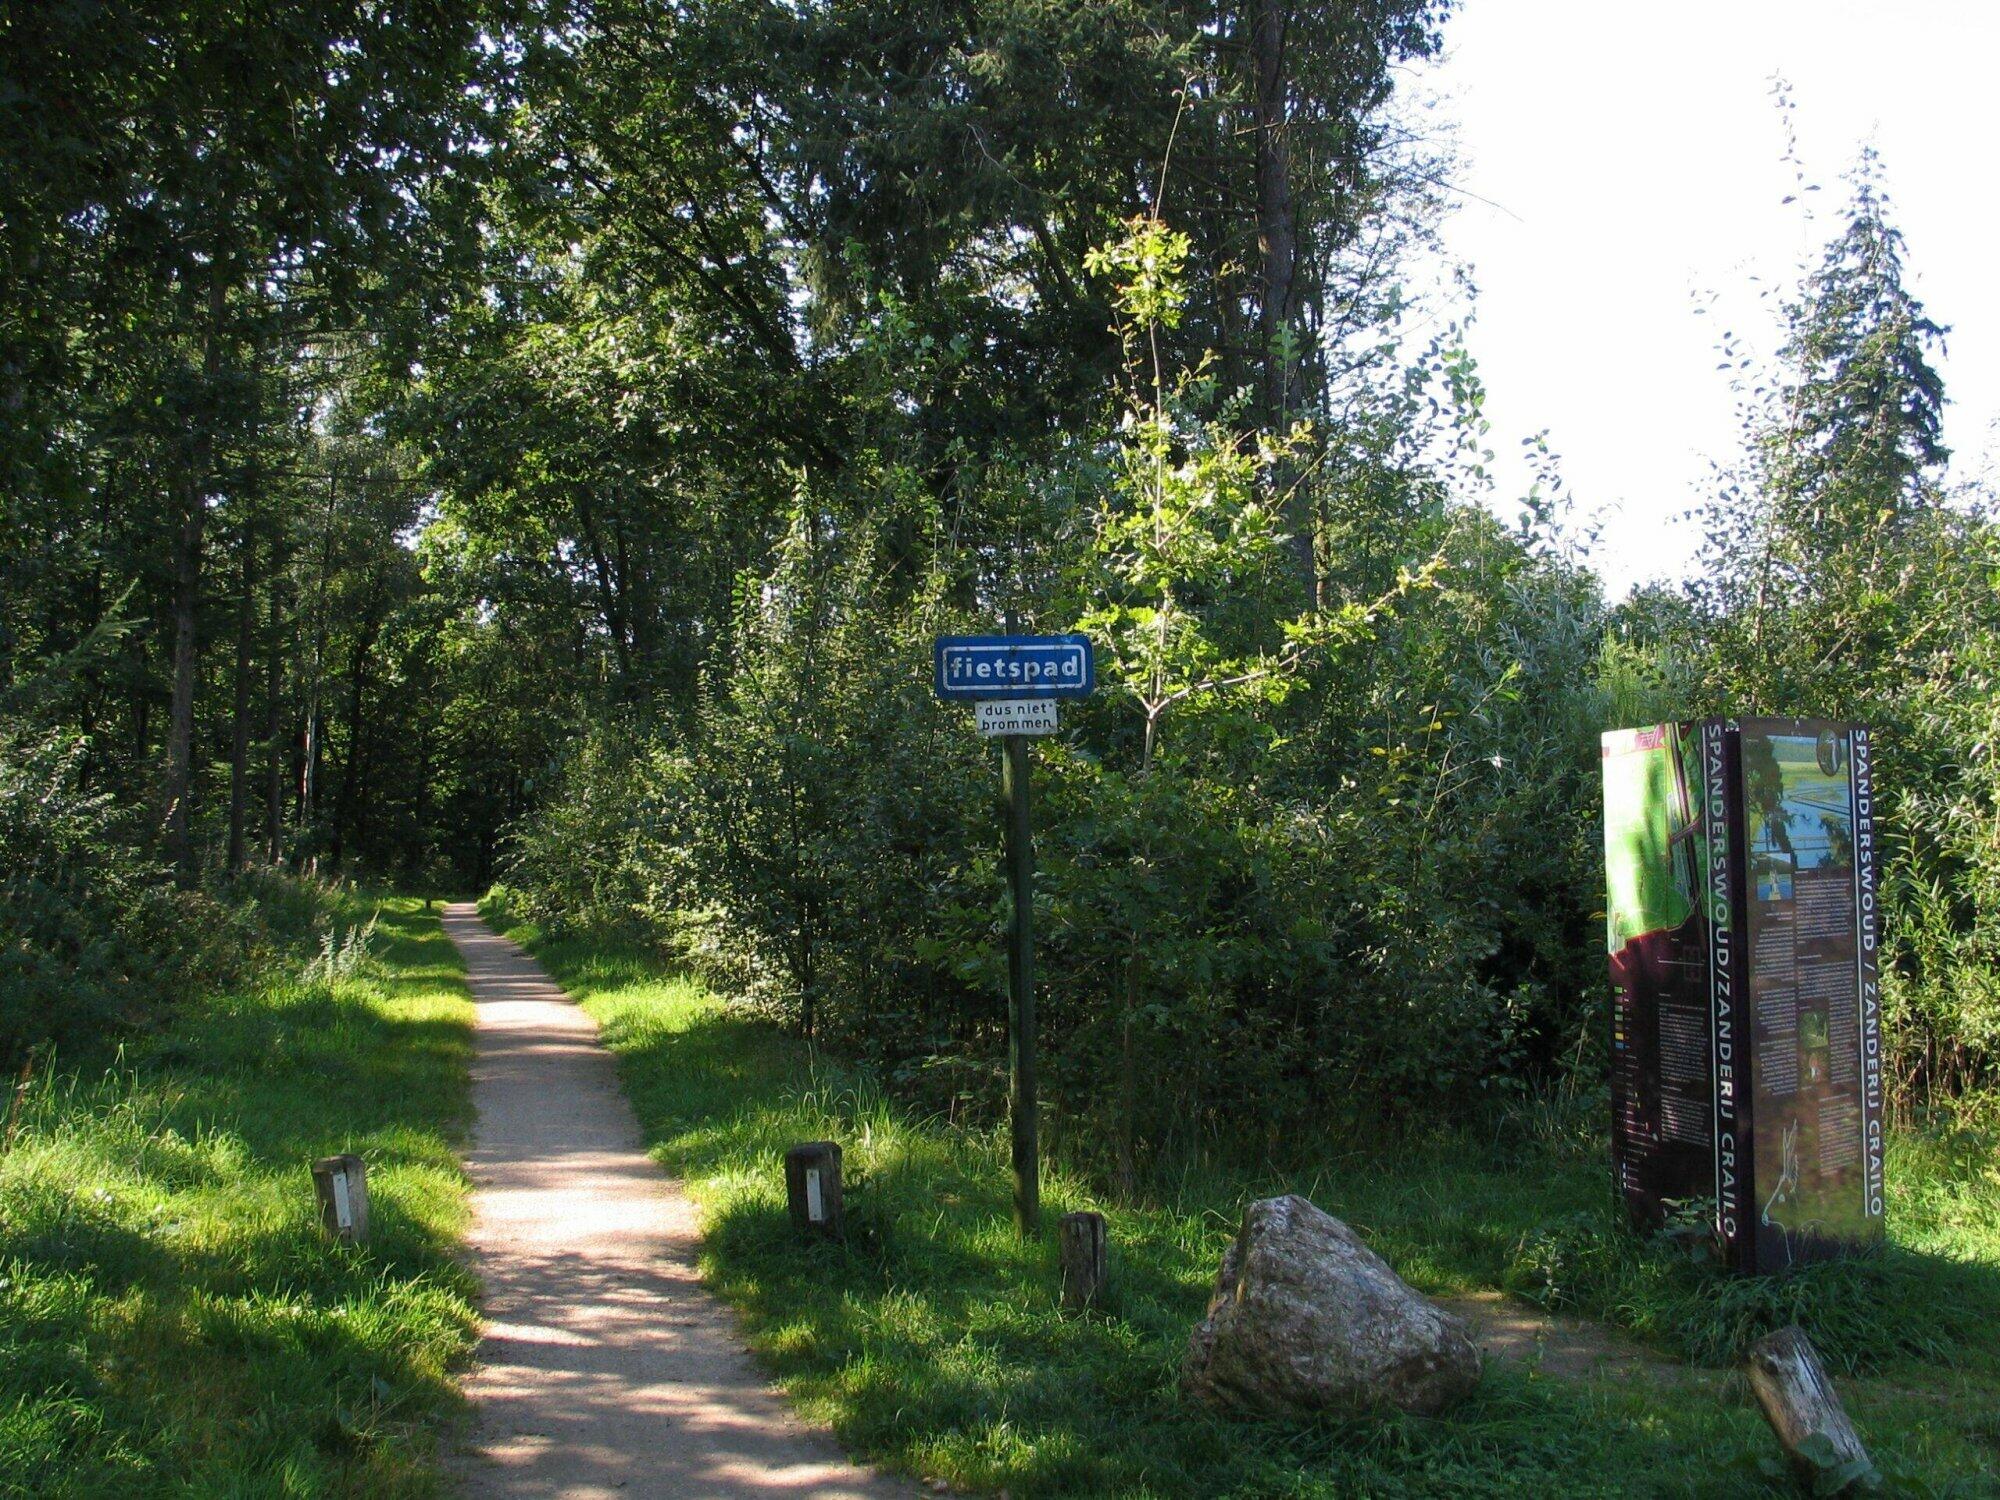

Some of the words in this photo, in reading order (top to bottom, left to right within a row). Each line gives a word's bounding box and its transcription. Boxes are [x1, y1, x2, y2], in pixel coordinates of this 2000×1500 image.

[951, 655, 1078, 682] fietspad
[985, 705, 1012, 716] dus
[1017, 703, 1047, 715] niet
[982, 719, 1053, 731] brommen
[1855, 729, 1875, 951] SPANDERSWOUD
[1864, 982, 1879, 1109] ZANDERIJ
[1718, 1132, 1737, 1238] CRAILO
[1868, 1119, 1882, 1216] CRAILO
